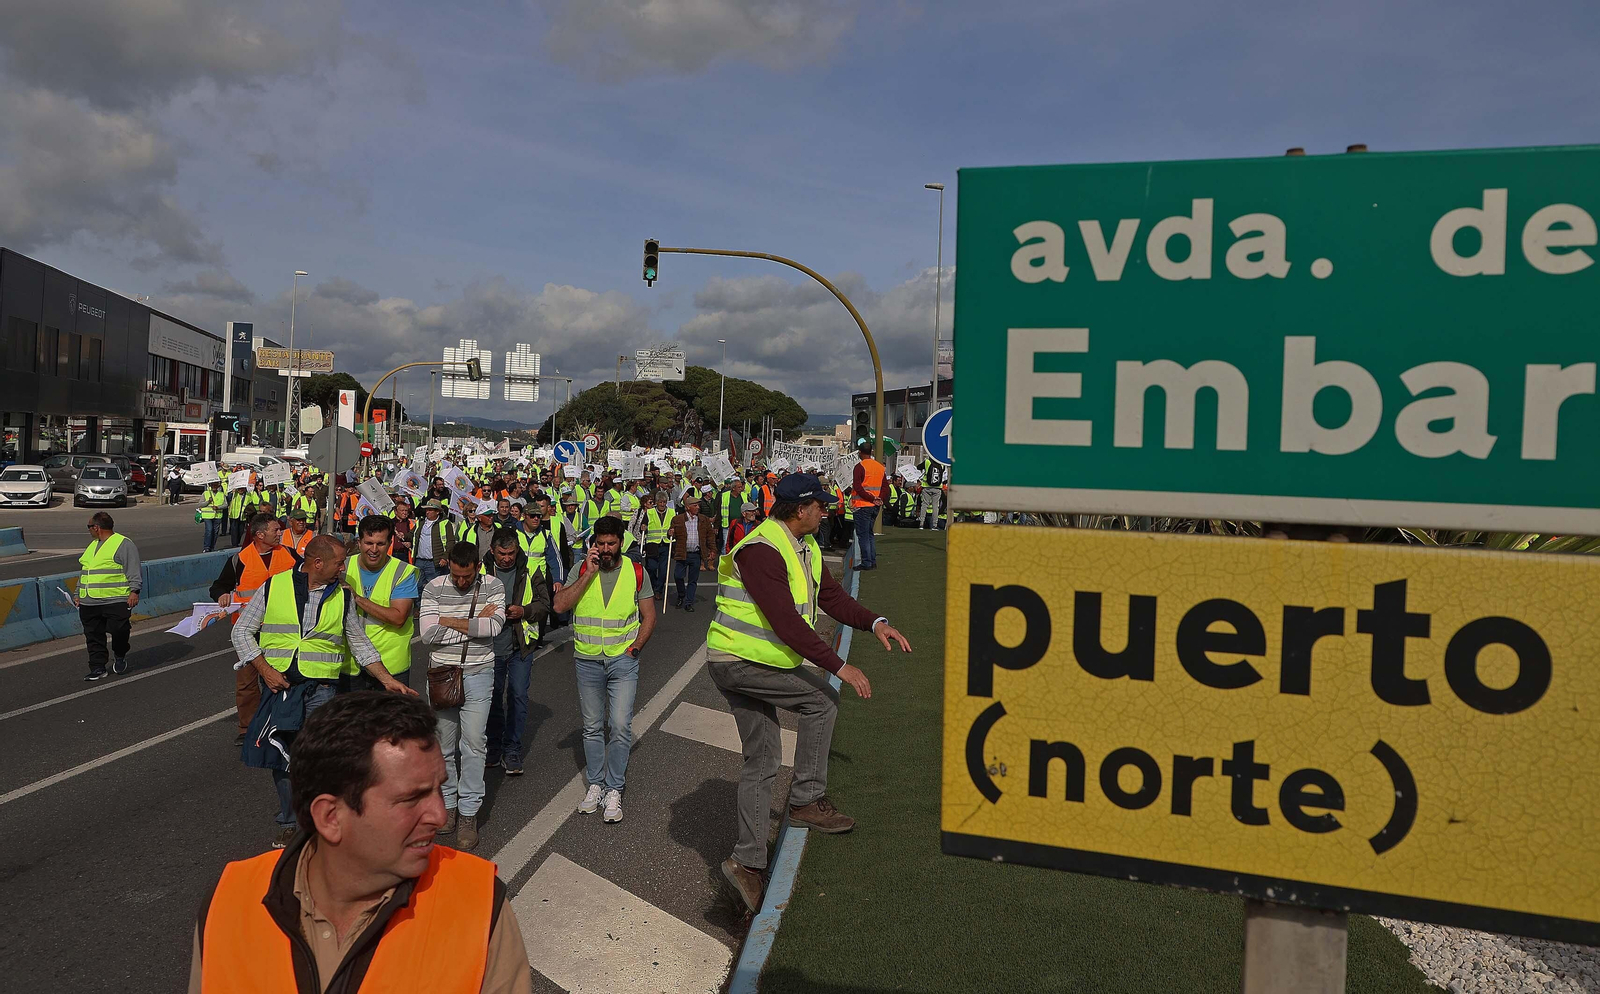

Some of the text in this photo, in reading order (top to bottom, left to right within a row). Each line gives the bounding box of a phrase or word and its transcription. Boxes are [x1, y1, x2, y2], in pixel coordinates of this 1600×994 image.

[1011, 188, 1599, 283] avda. de
[78, 302, 106, 319] PEUGEOT
[258, 349, 332, 361] RESTAURANTE
[258, 359, 280, 367] BAR
[1004, 328, 1598, 460] Embar
[779, 443, 792, 452] LOS
[819, 446, 833, 455] QUE
[966, 578, 1553, 716] puerto
[965, 700, 1419, 856] (norte)
